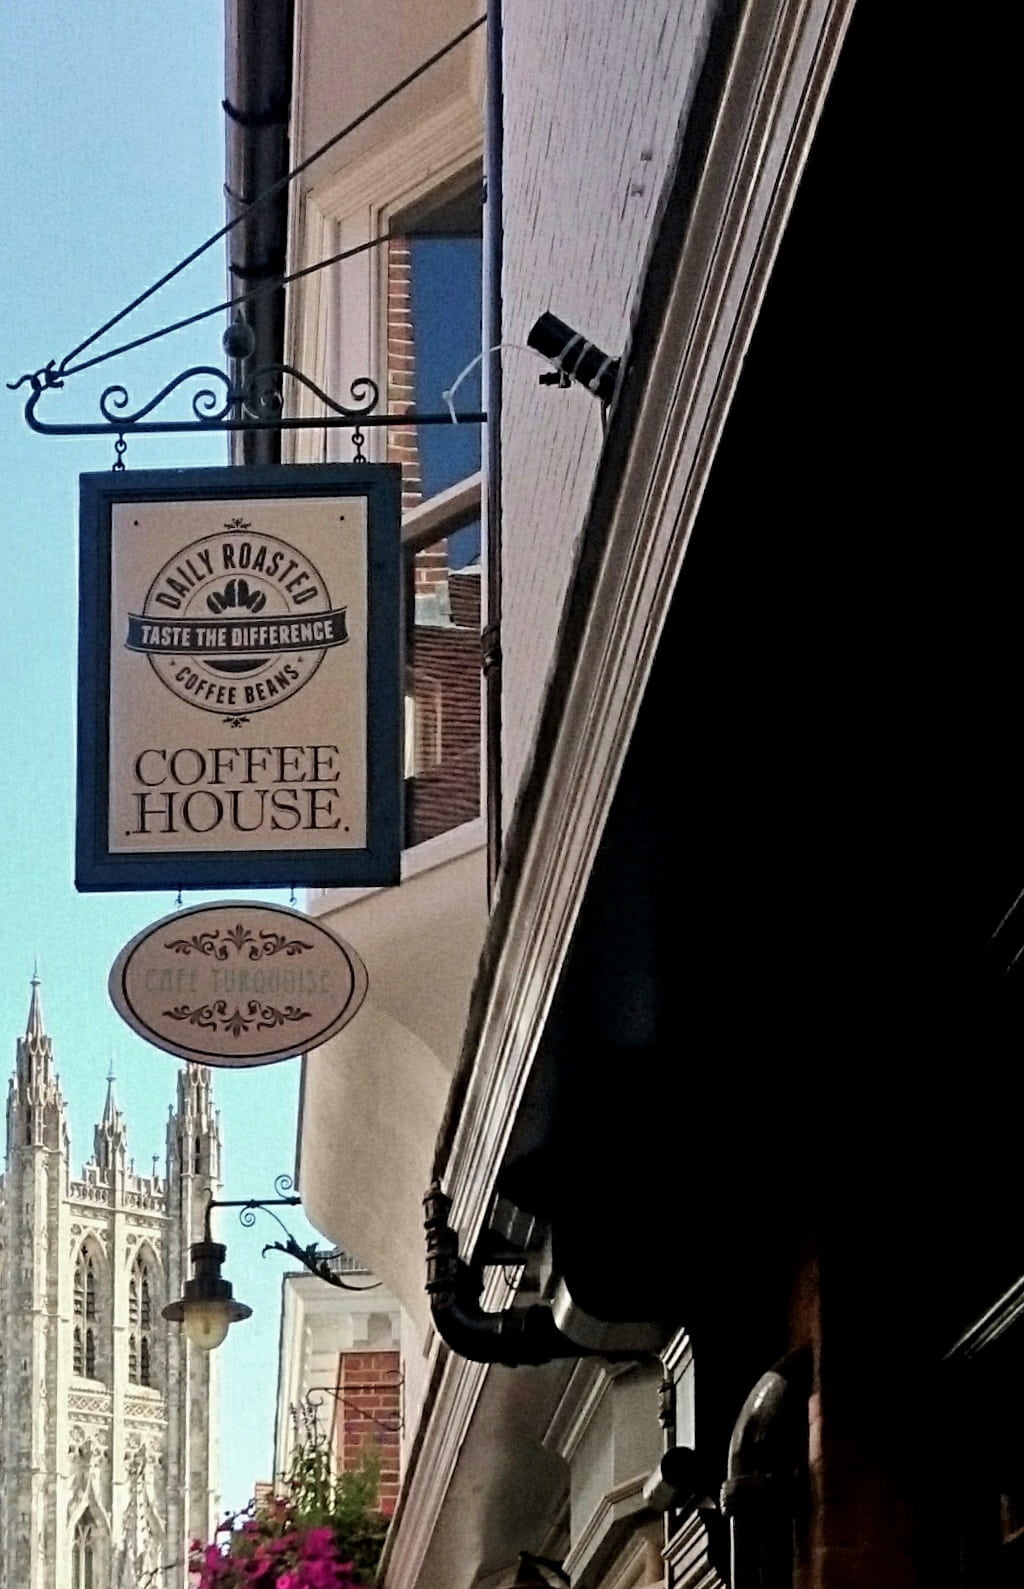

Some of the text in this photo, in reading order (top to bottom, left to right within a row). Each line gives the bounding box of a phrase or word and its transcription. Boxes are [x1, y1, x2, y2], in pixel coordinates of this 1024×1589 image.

[155, 542, 318, 610] DAILY ROASTED
[141, 620, 335, 647] TASTE THE DIFFERENCE
[175, 664, 299, 705] COFFEE BEANS
[133, 745, 341, 788] COFFEE
[131, 787, 342, 835] HOUSE
